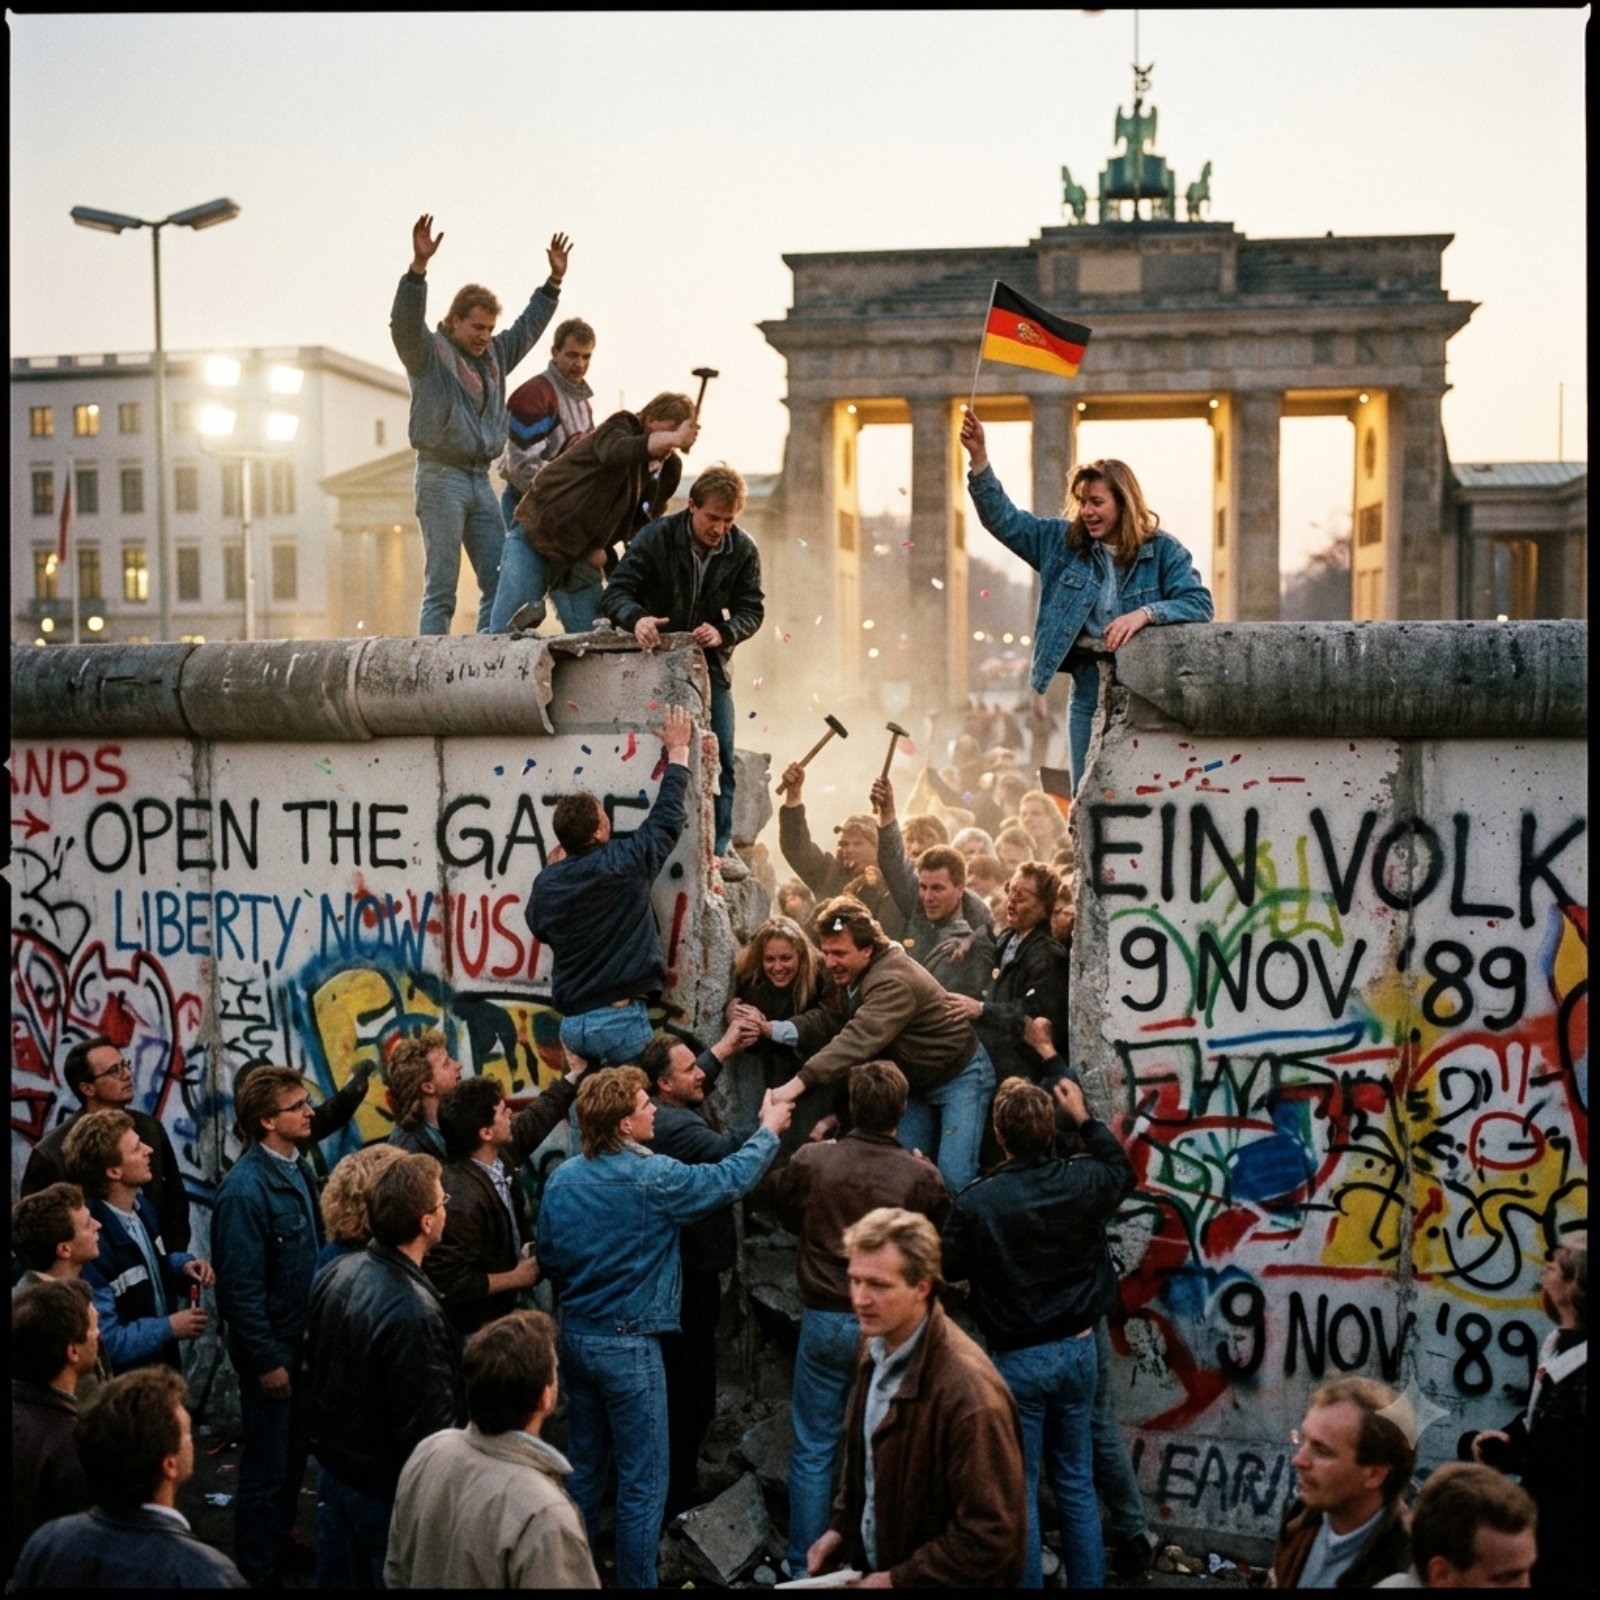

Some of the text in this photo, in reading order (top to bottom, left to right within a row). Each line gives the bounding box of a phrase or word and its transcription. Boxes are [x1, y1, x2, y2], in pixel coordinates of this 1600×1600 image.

[11, 745, 127, 798] NDS
[85, 793, 650, 880] OPEN THE GAE
[1089, 802, 1586, 928] EIN VOLK
[114, 889, 302, 970] LIBERTY
[320, 891, 434, 975] NOW
[1120, 926, 1527, 1031] 9 NOV '89
[1216, 1280, 1539, 1406] 9 NOV '89
